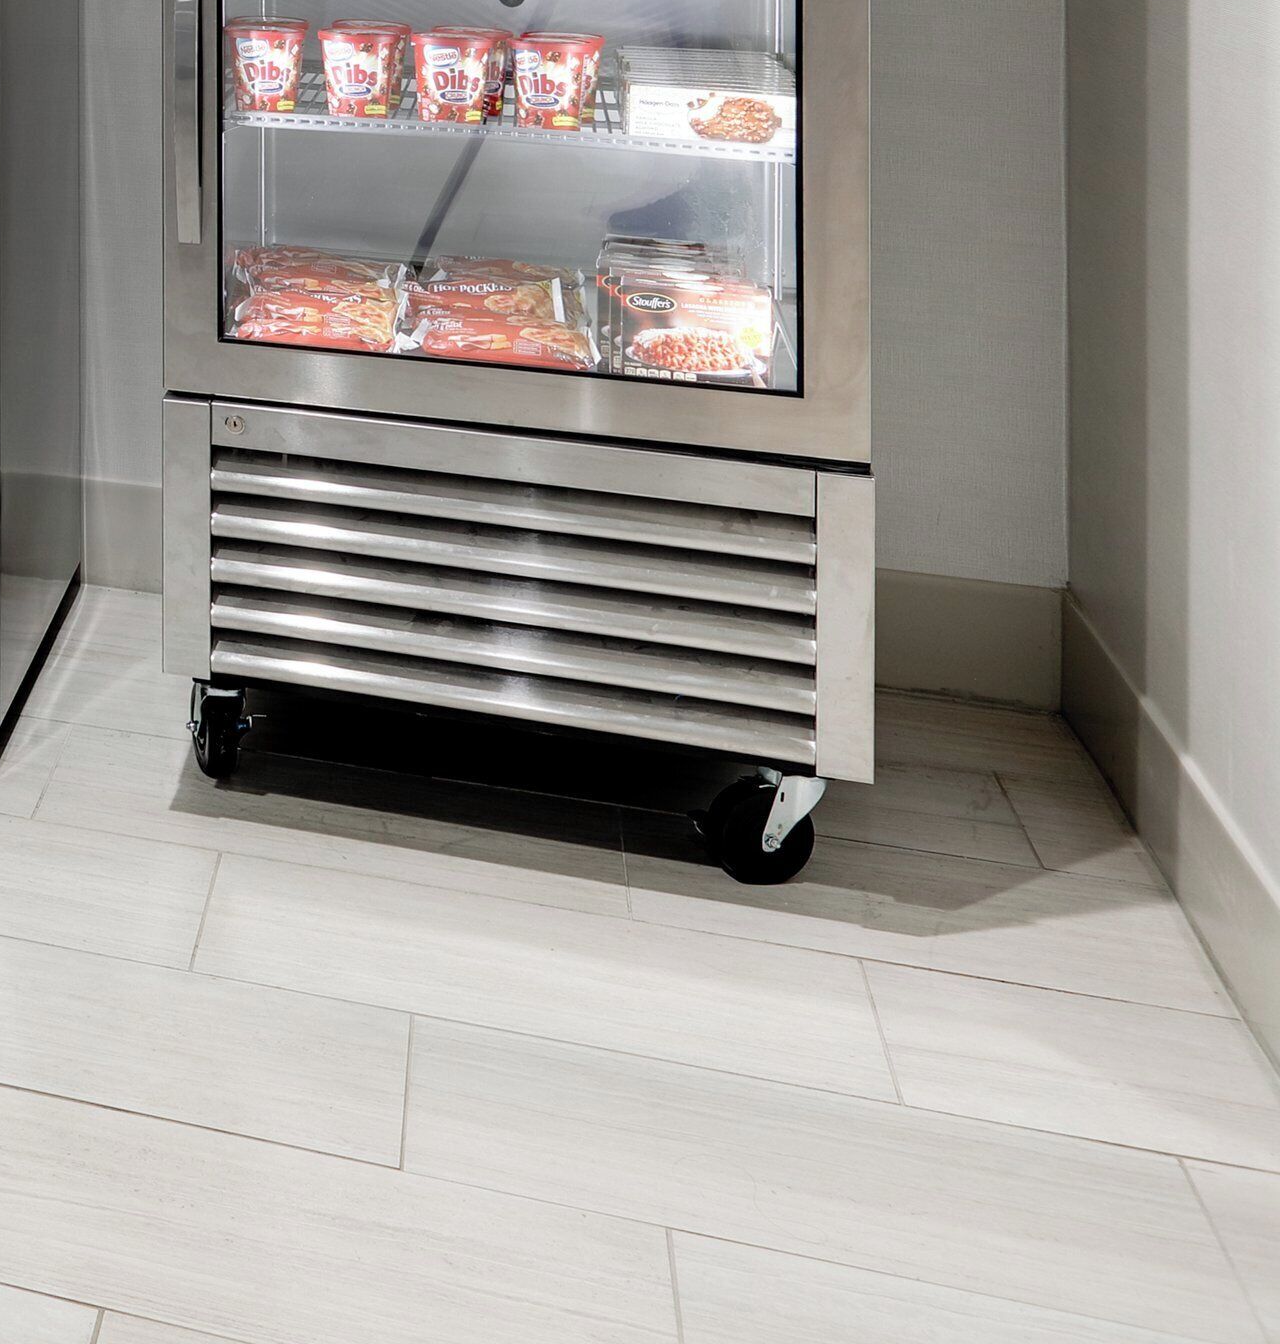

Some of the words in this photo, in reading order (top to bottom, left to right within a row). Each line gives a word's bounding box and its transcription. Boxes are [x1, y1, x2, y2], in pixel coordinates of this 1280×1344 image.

[243, 60, 291, 84] Dibs
[331, 64, 379, 86] Dibs
[431, 67, 481, 93] Dibs
[517, 73, 569, 97] Dibs
[434, 284, 460, 294] HOT
[460, 283, 513, 294] POCKETS
[632, 295, 672, 310] Stouffer's
